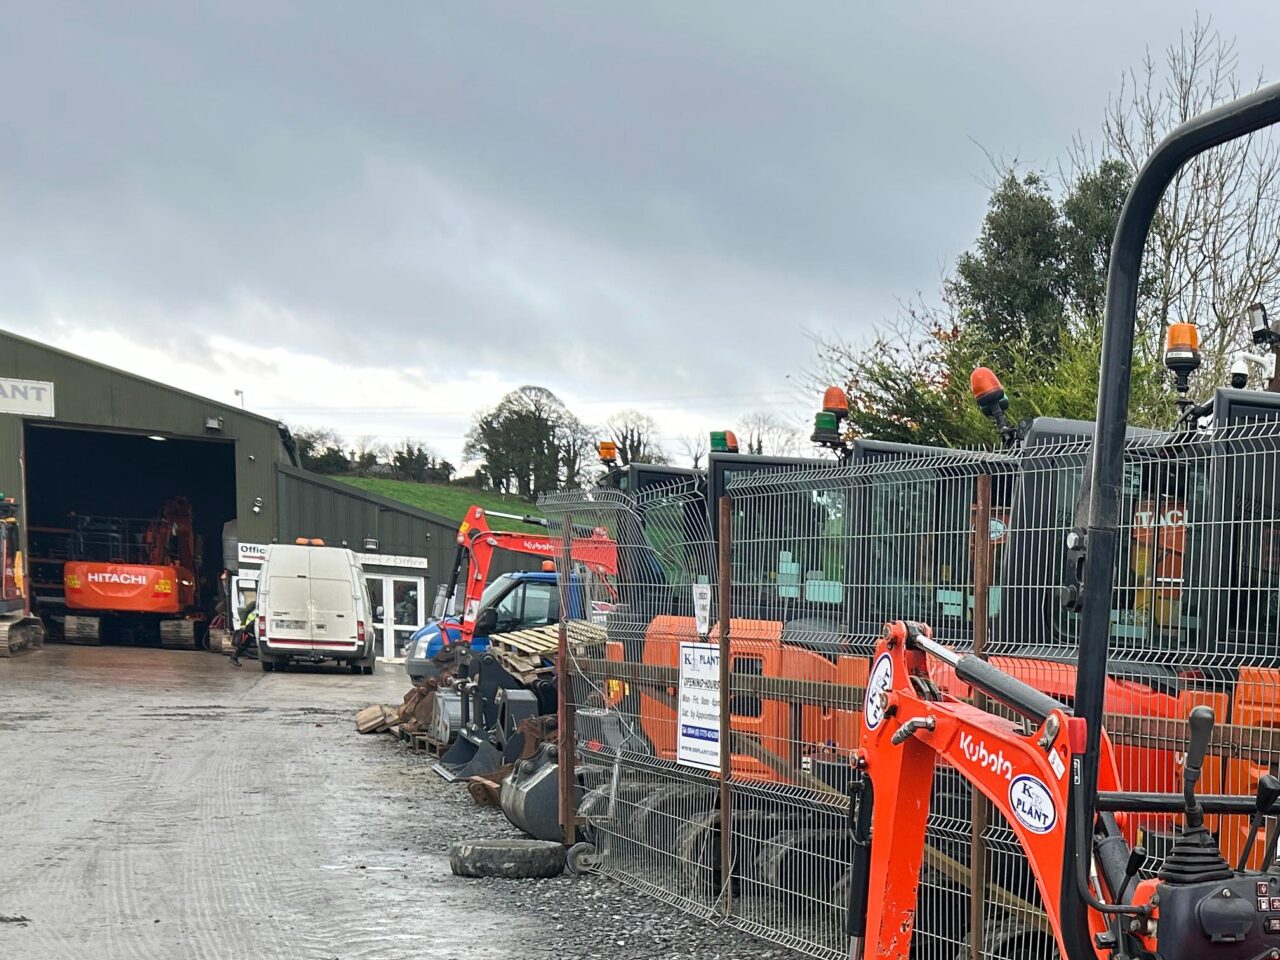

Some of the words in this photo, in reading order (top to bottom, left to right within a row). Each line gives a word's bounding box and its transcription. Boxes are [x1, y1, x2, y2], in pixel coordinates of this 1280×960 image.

[240, 545, 266, 554] Offic
[88, 573, 146, 584] HITACHI
[960, 731, 1013, 780] Kubota
[1016, 798, 1049, 826] PLANT
